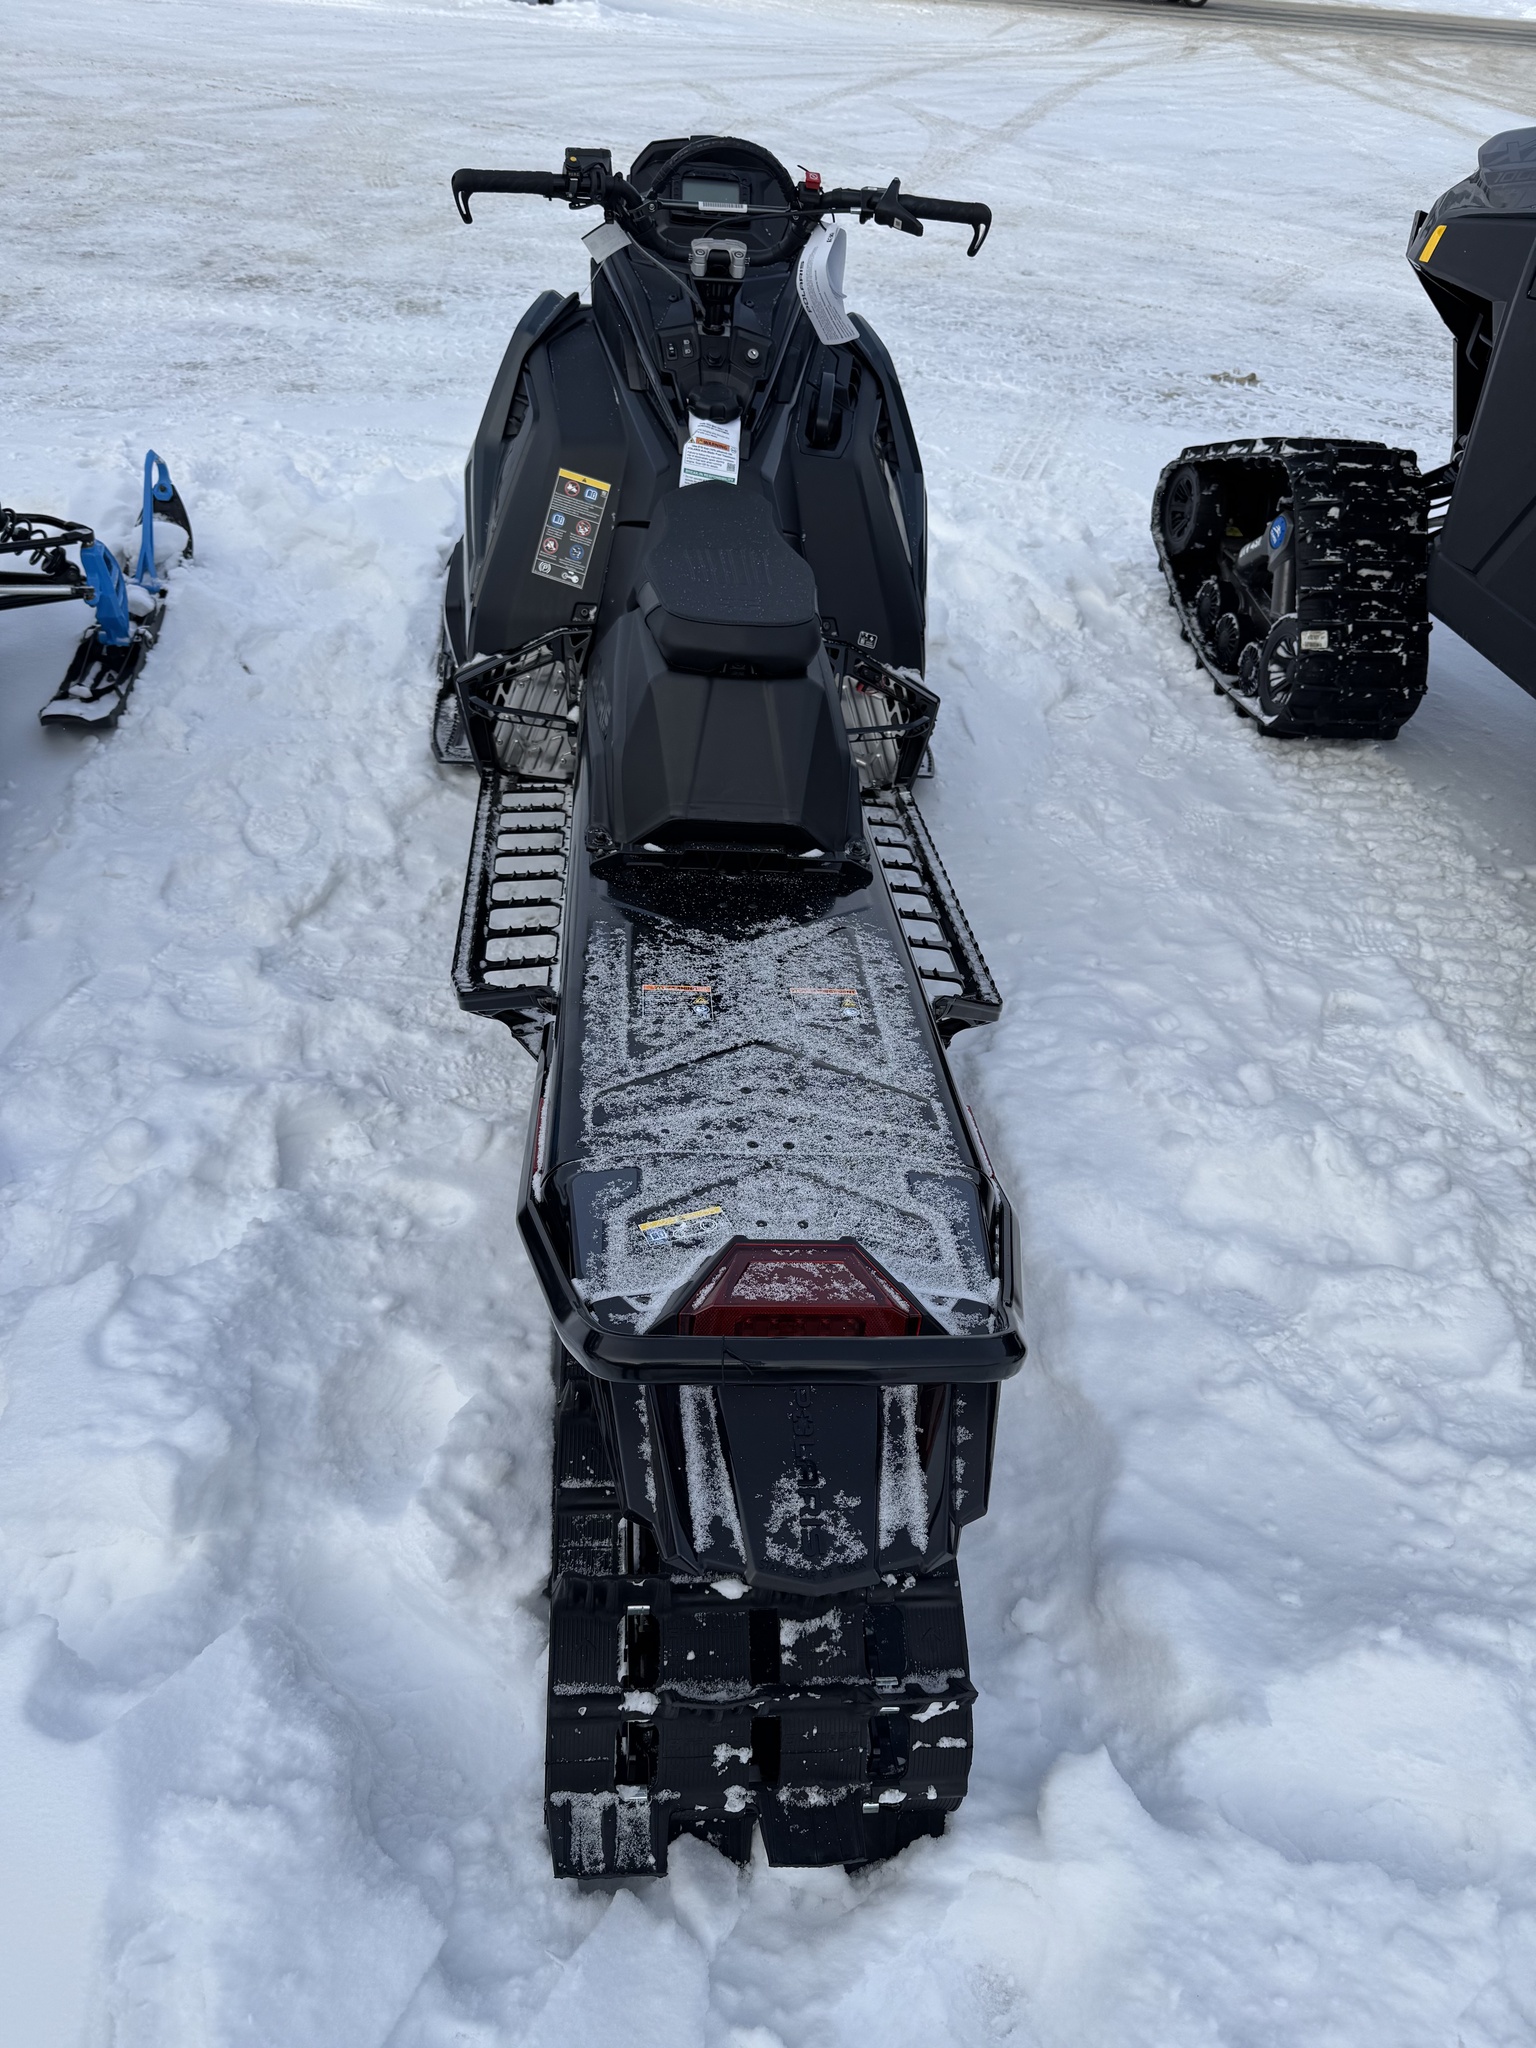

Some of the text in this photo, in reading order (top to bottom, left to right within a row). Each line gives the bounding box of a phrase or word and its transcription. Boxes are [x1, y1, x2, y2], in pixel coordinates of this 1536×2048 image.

[799, 261, 812, 313] POLARIS
[703, 440, 728, 450] WARNING
[790, 1386, 826, 1558] POLARIS
